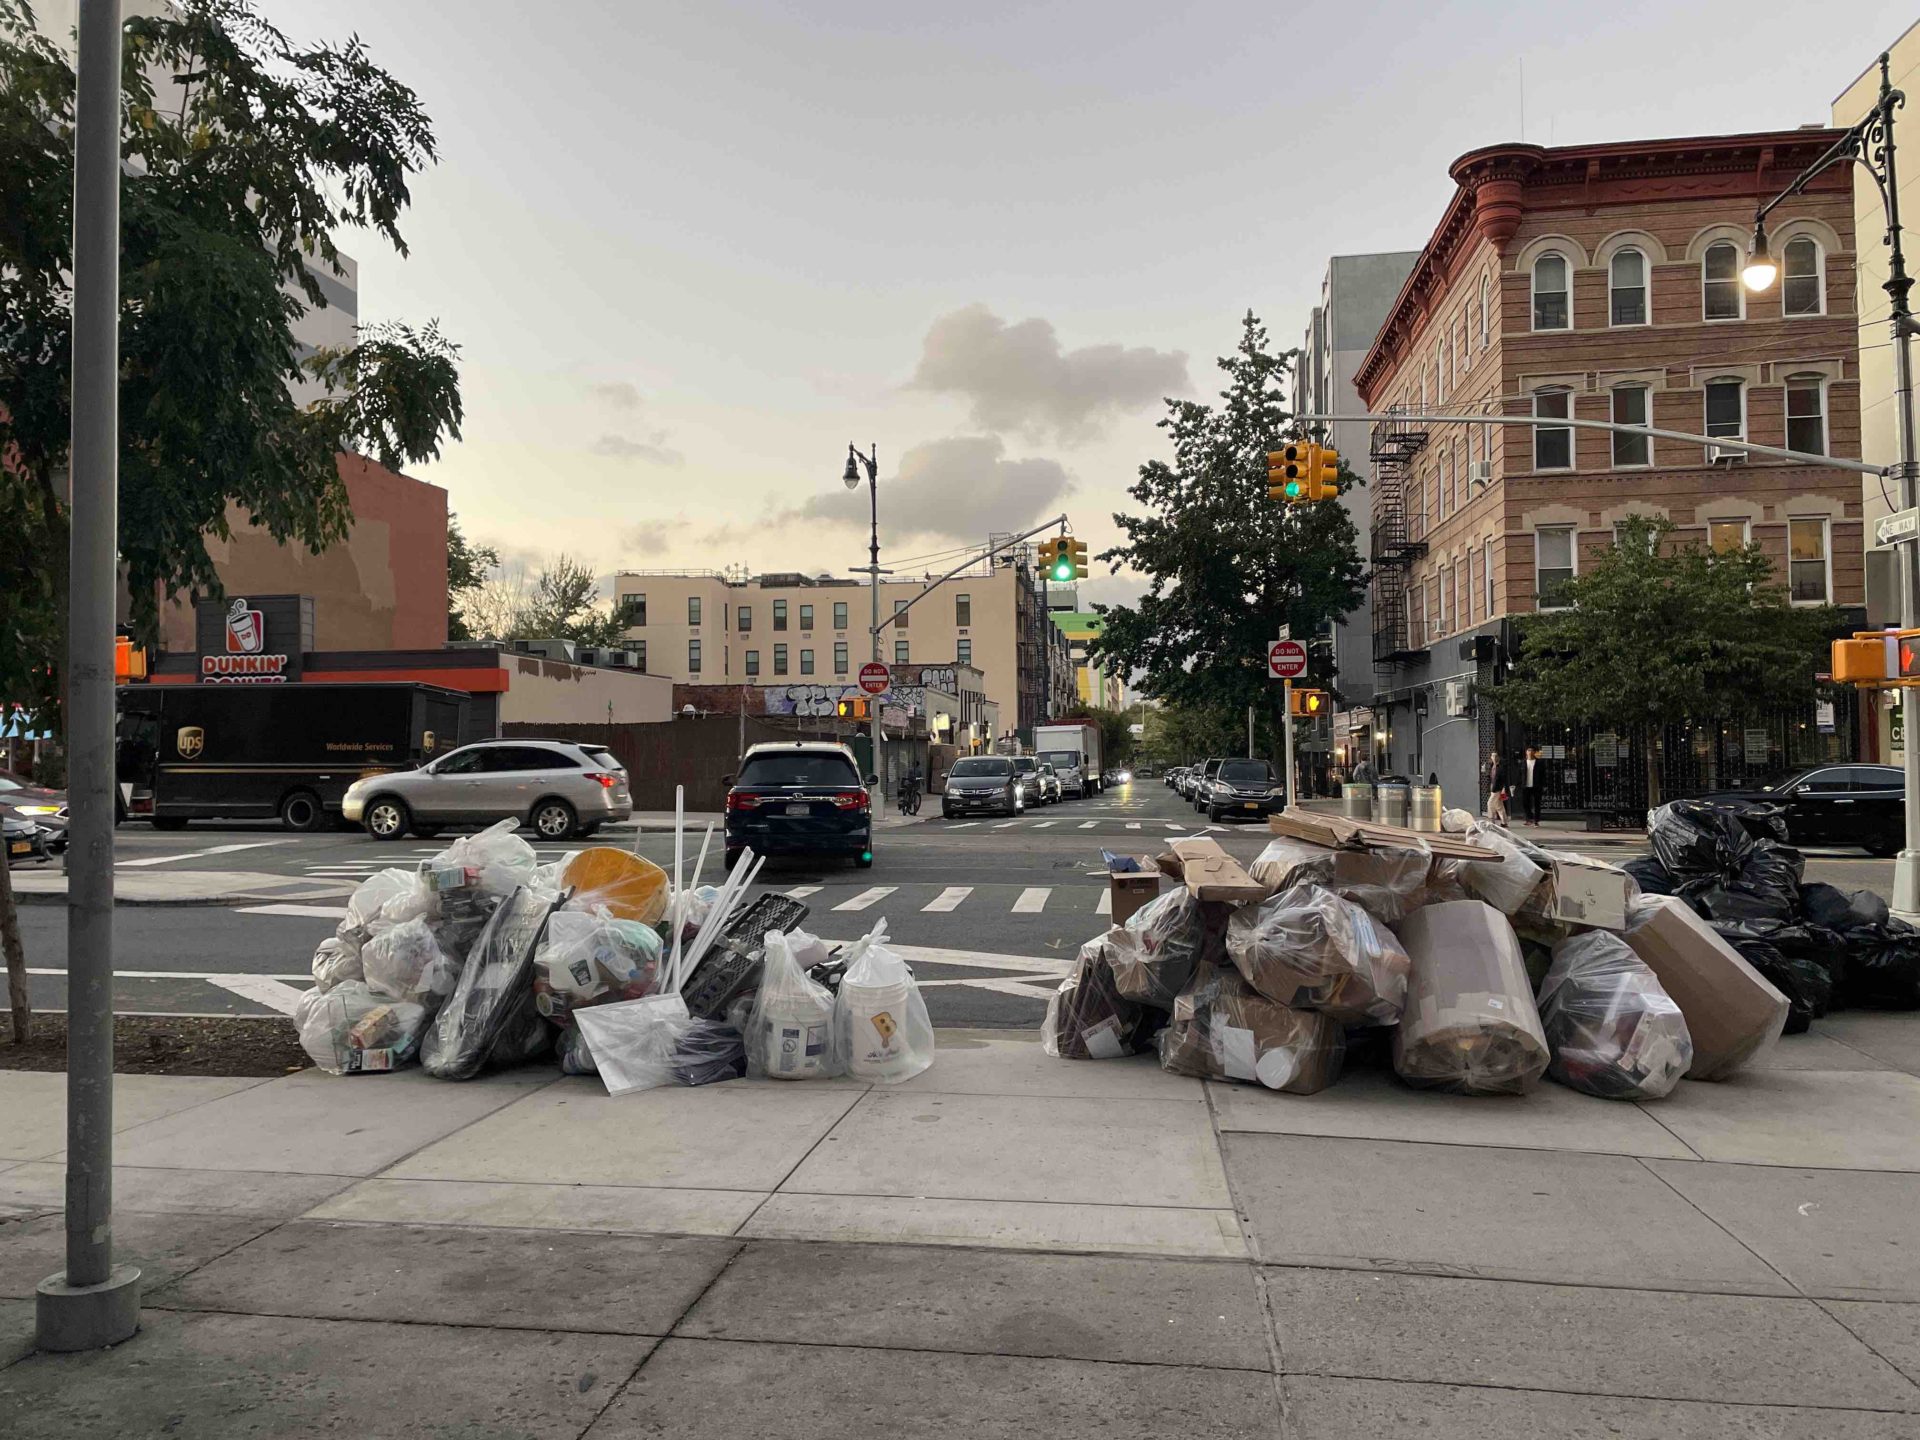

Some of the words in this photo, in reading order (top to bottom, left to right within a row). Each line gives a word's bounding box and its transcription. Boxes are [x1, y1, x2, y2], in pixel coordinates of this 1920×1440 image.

[1881, 524, 1894, 538] ONE
[1899, 518, 1913, 532] WAY
[1286, 647, 1299, 655] NOT
[202, 655, 286, 674] DUNKIN'
[1277, 663, 1299, 671] ENTER
[180, 736, 202, 754] ups
[326, 743, 363, 751] Worldwide
[364, 743, 394, 751] Services
